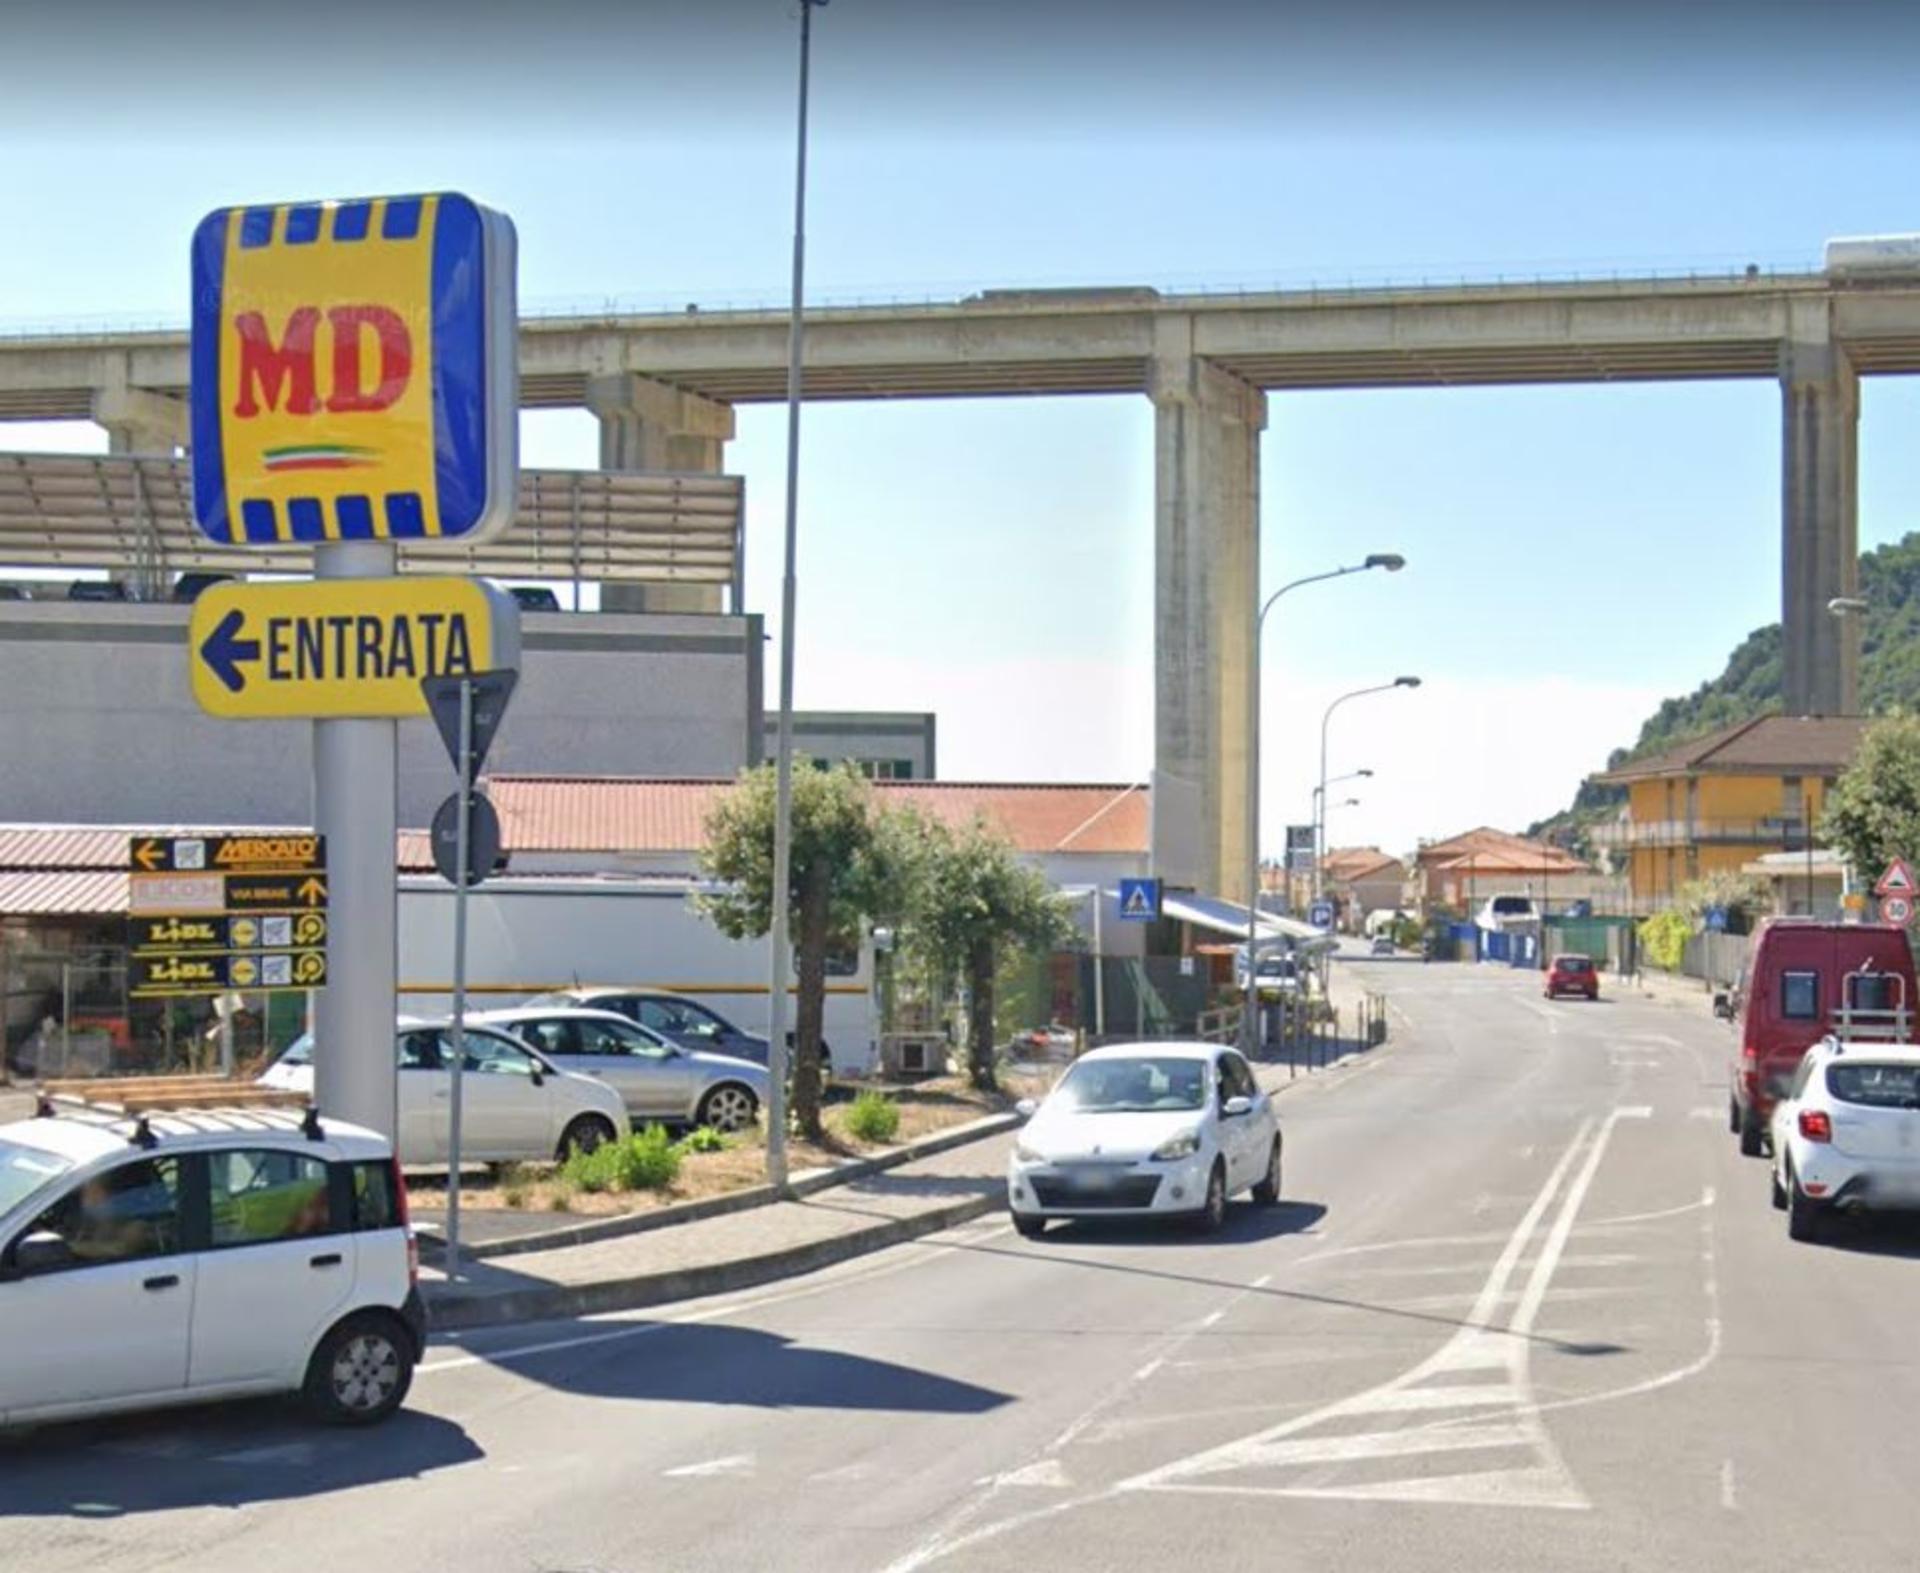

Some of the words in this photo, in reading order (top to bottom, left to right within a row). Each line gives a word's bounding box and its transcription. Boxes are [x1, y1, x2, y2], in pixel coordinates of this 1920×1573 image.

[233, 306, 413, 419] MD
[268, 614, 472, 680] ENTRATA
[215, 838, 315, 863] MERCATO
